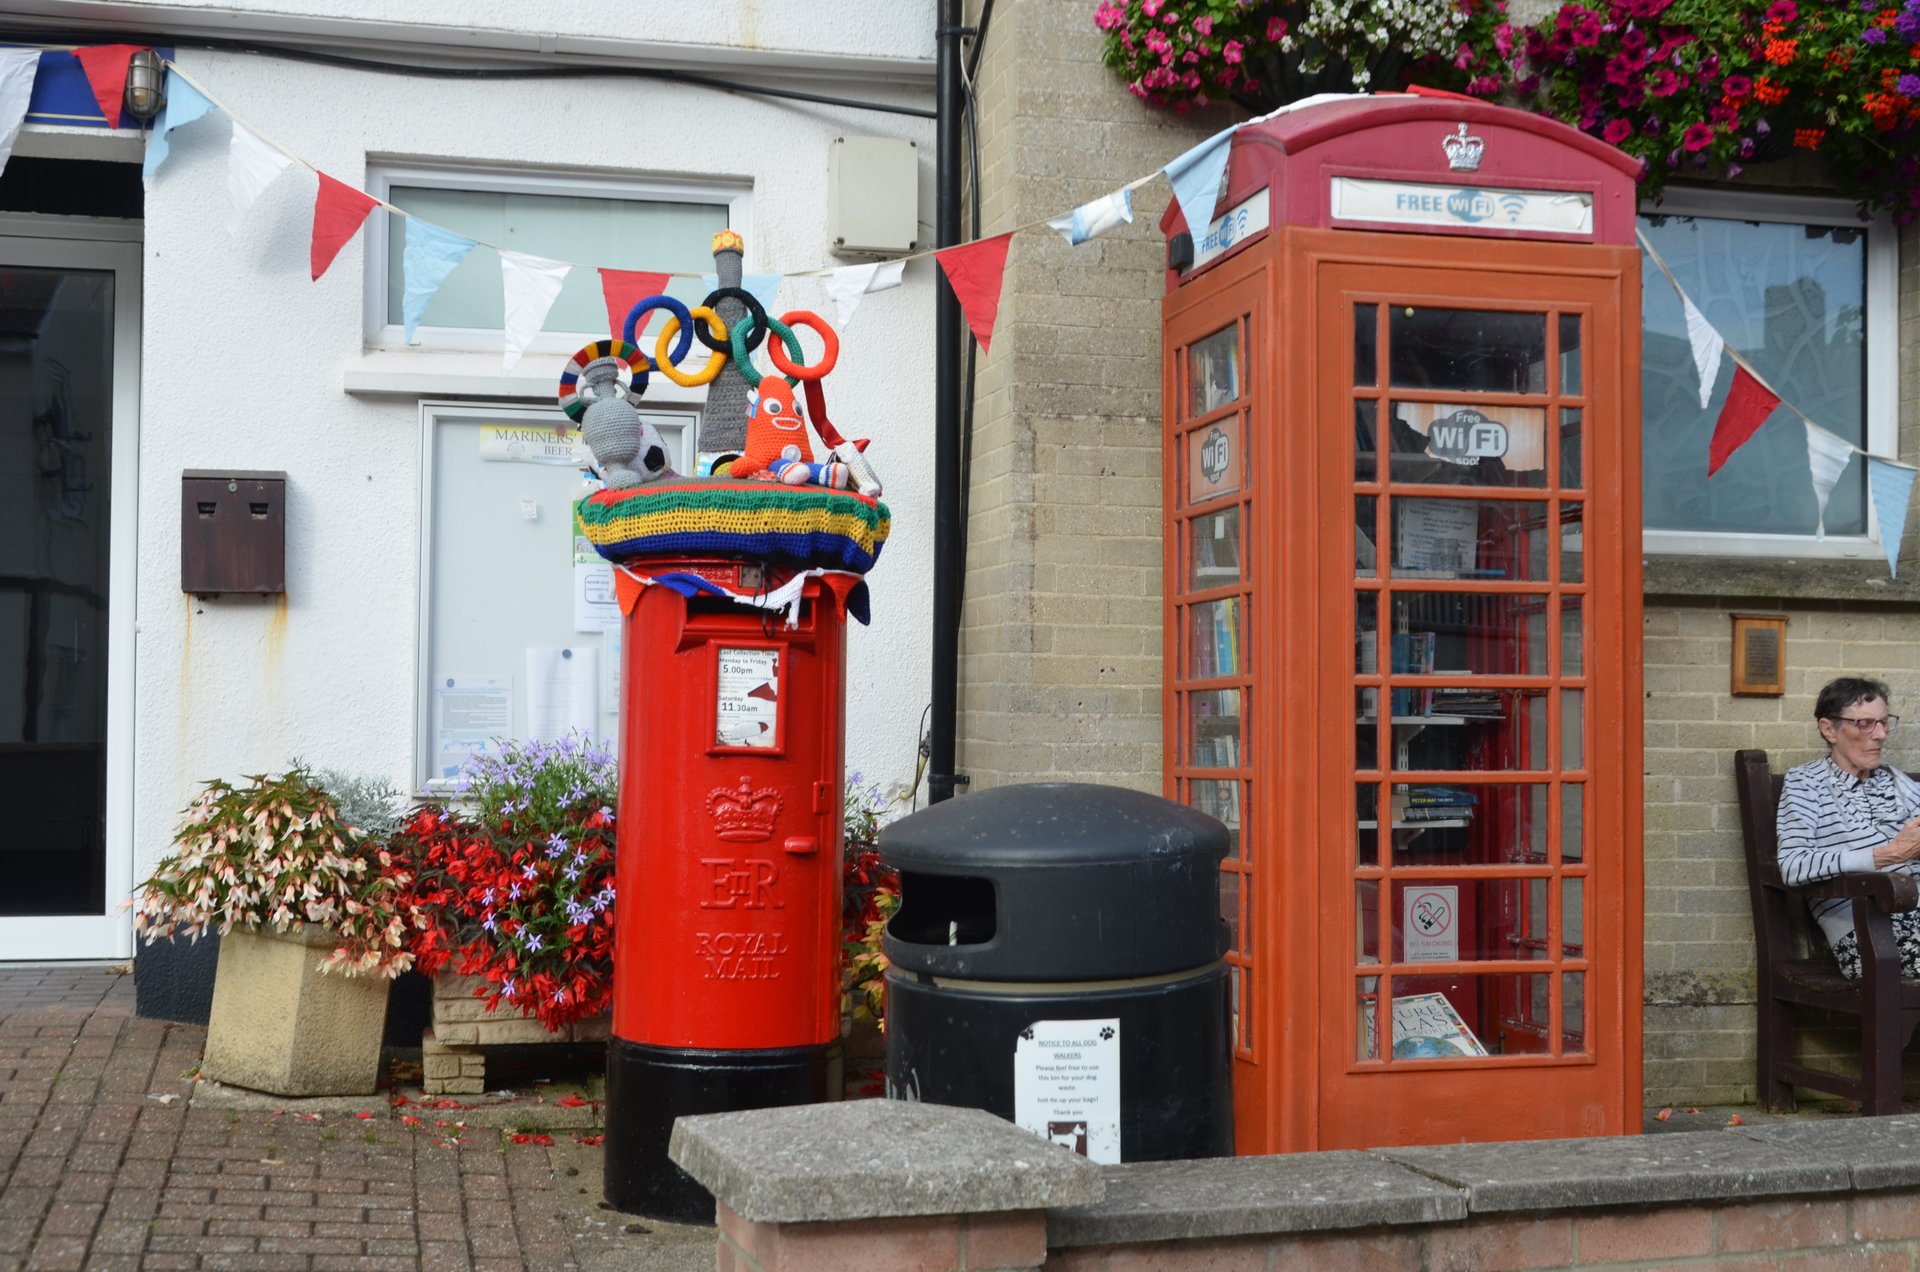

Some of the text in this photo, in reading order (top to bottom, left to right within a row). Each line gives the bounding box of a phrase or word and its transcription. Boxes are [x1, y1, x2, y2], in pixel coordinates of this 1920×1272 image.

[1397, 193, 1442, 212] FREE
[1456, 412, 1481, 424] Free
[495, 429, 577, 445] MARINERS'
[1432, 426, 1500, 451] WiFi
[544, 445, 573, 456] BEER
[723, 664, 753, 674] 5.00pm
[722, 702, 758, 712] 11.30am
[695, 932, 788, 955] ROYAL
[704, 956, 780, 981] MAIL
[1083, 1039, 1097, 1047] DOG
[1053, 1052, 1081, 1060] WALKERS
